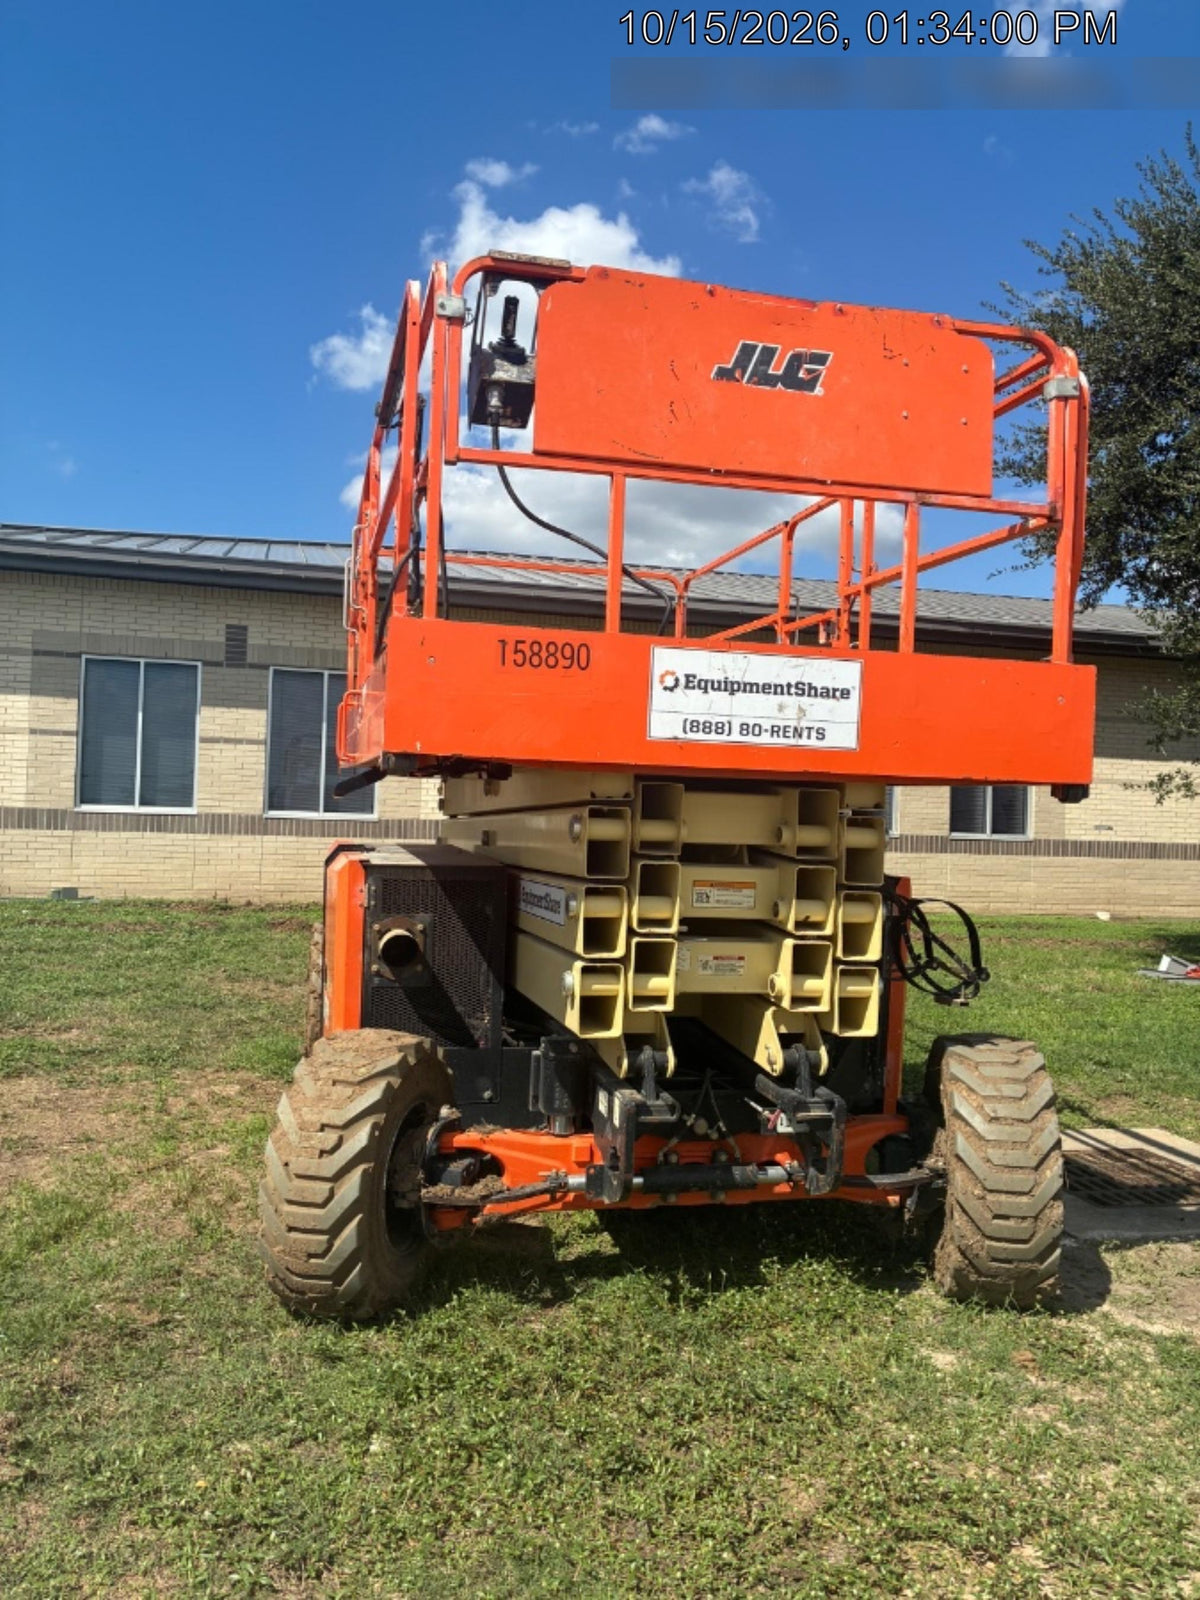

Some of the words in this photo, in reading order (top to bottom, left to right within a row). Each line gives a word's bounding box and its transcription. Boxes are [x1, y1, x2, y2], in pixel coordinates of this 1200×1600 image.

[711, 339, 834, 395] JLG
[498, 639, 591, 671] 158890
[683, 673, 851, 700] EquipmentShare
[682, 718, 732, 736] (888)
[739, 723, 826, 741] 80-RENTS
